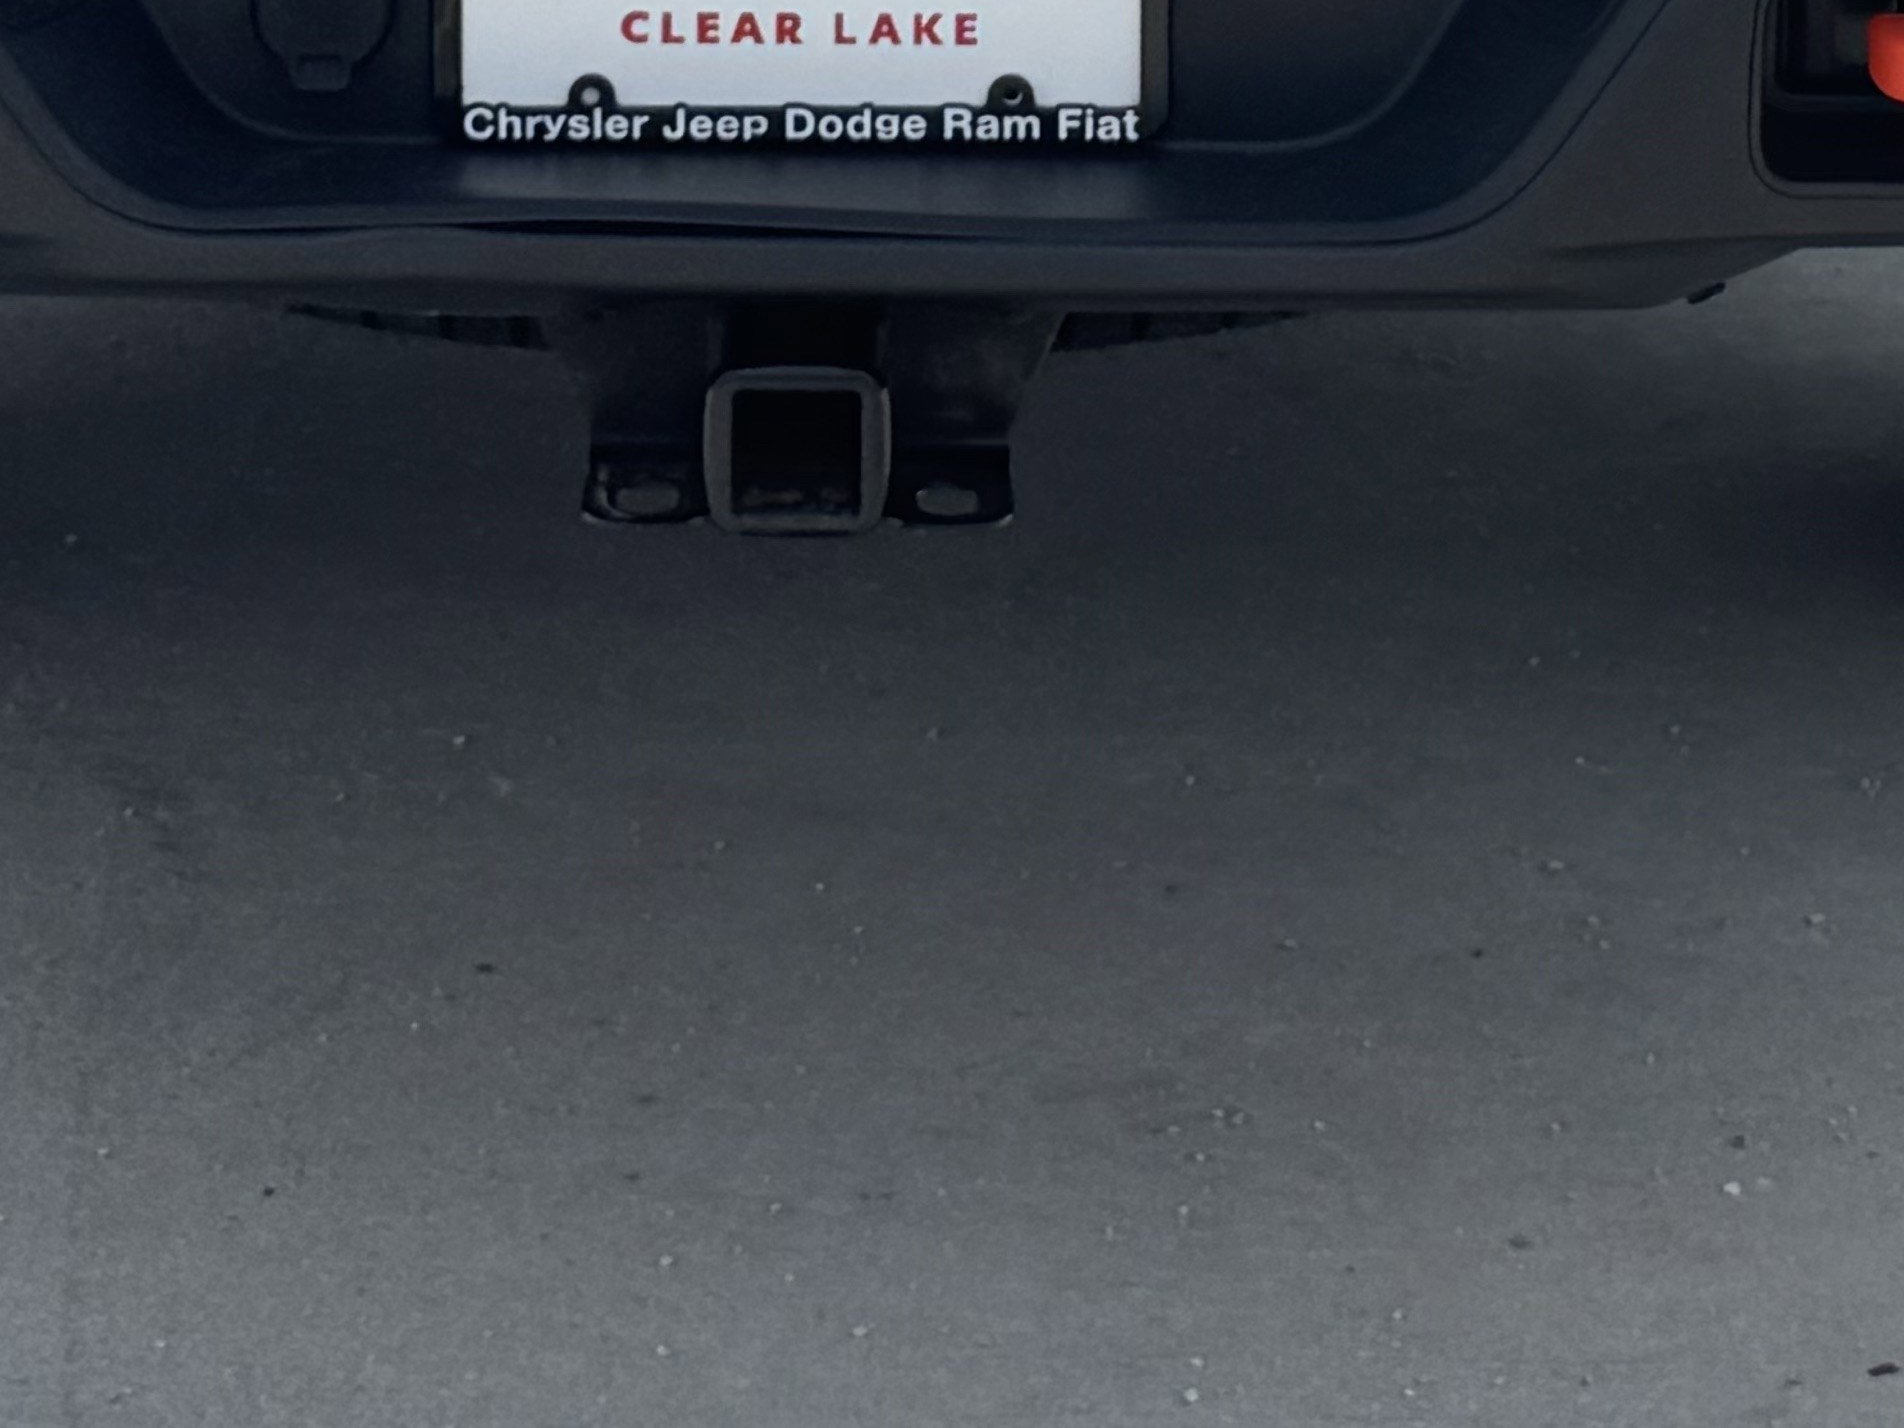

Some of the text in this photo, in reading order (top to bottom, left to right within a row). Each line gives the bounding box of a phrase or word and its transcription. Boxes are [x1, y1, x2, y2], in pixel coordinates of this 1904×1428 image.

[620, 10, 979, 46] CLEAR LAKE
[462, 107, 1141, 142] Chrysler Jeep Dodge Ram Fiat
